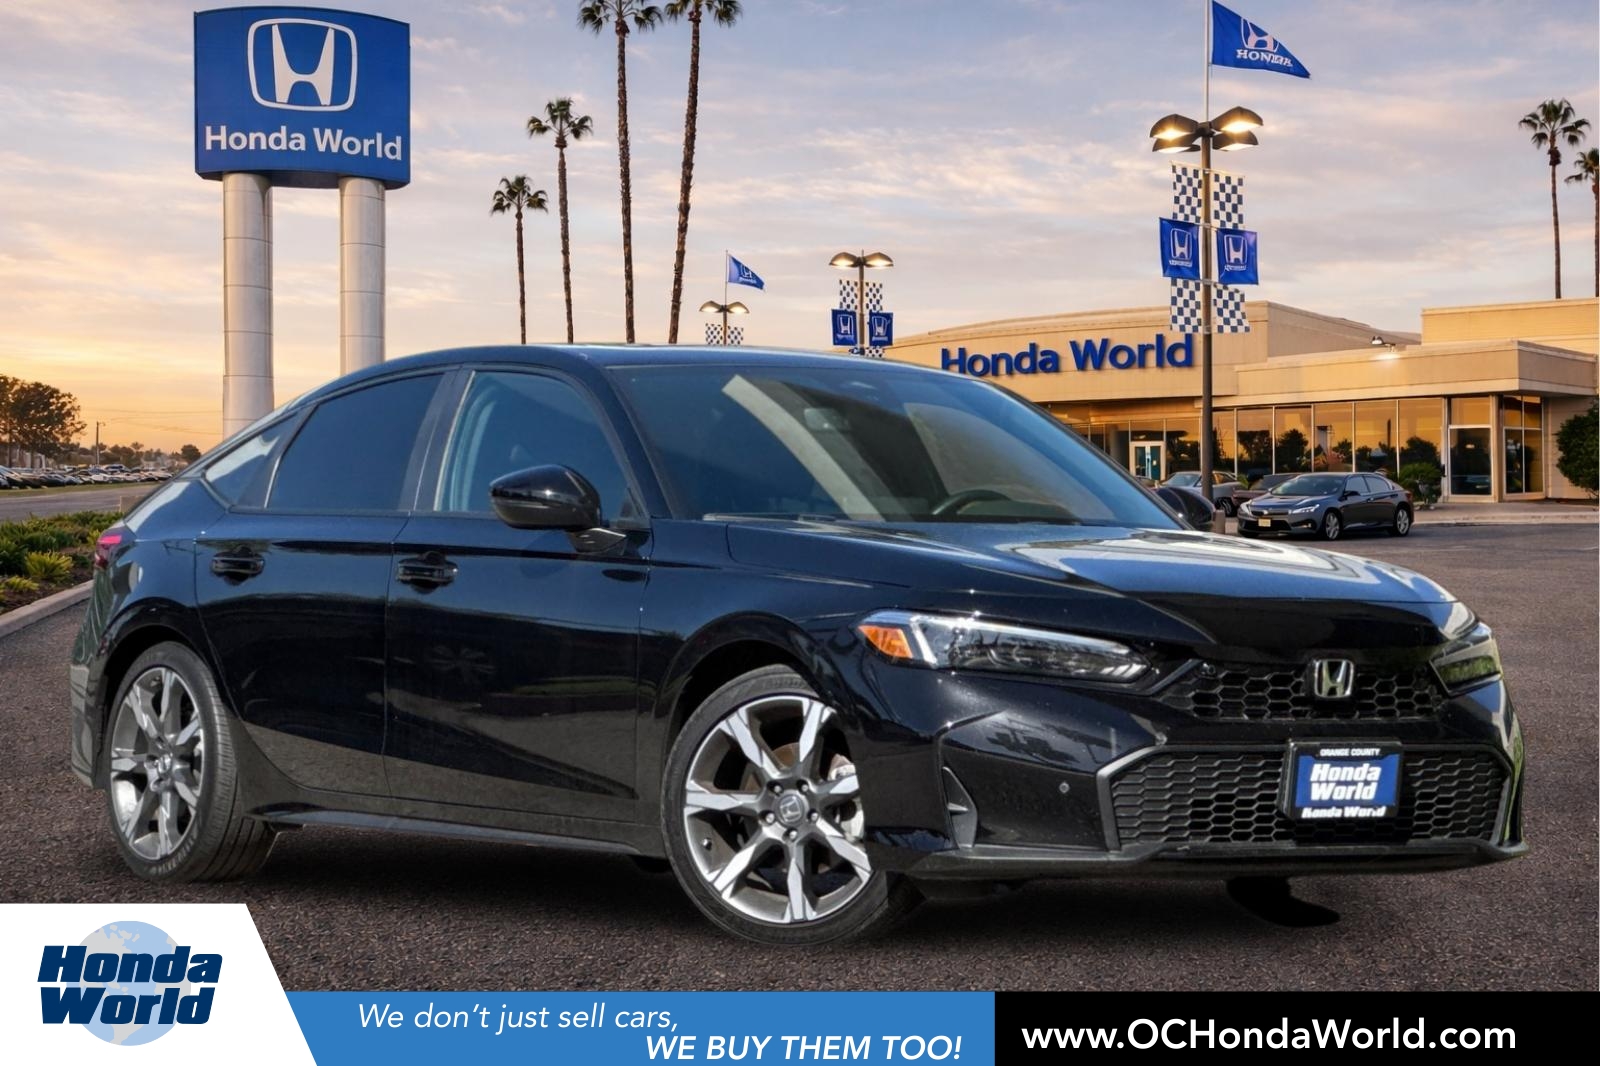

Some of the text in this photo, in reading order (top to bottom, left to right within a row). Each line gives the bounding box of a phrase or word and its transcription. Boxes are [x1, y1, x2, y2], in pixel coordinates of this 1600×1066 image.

[205, 125, 402, 160] Honda World
[941, 333, 1194, 378] Honda World
[1319, 748, 1381, 757] ORANGE COUNTY
[1310, 763, 1382, 781] Honda
[1310, 781, 1378, 801] World
